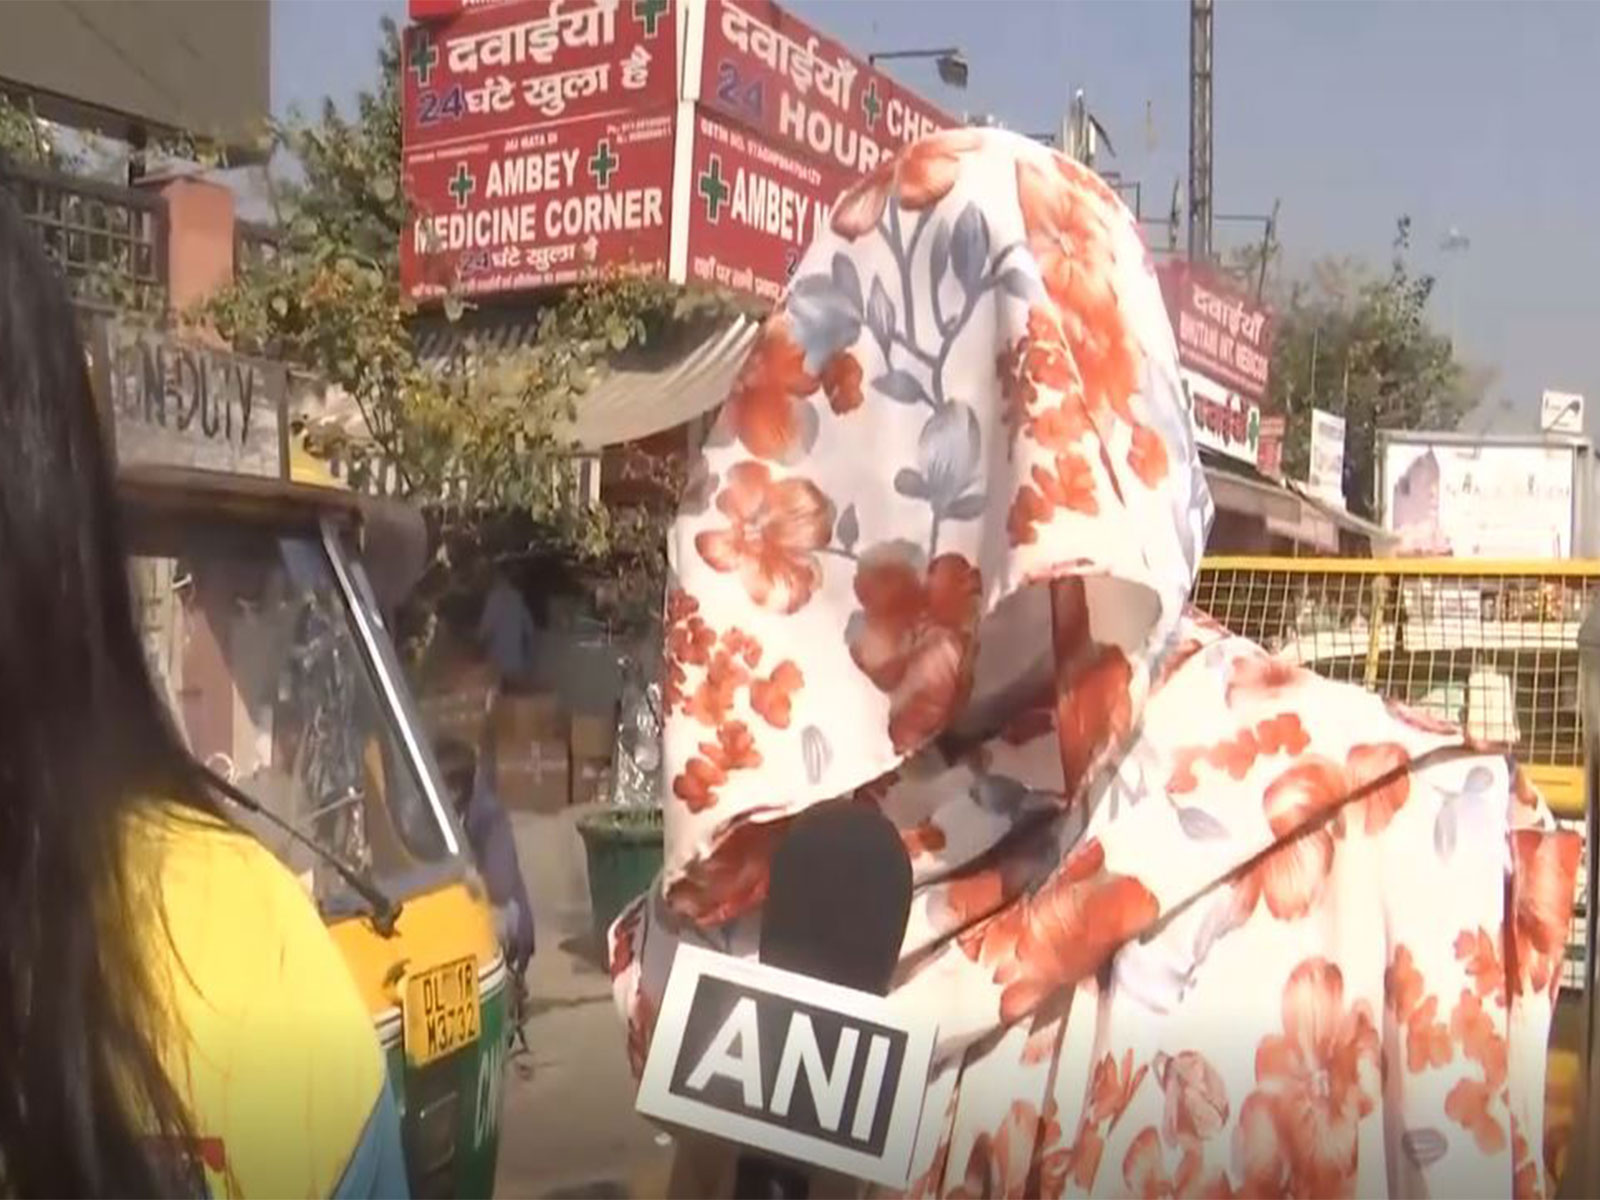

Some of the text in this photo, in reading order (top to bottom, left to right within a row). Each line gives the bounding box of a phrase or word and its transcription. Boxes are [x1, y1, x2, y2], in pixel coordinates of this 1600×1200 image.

[417, 83, 466, 127] 24
[522, 64, 610, 117] खुला
[620, 45, 652, 90] है
[717, 59, 764, 127] 24
[886, 97, 942, 146] CHE
[486, 149, 580, 199] AMBEY
[731, 167, 809, 246] AMBEY
[414, 188, 664, 254] MEDICINE CORNER
[526, 243, 576, 271] खुला
[423, 976, 444, 1017] DL
[685, 996, 891, 1143] ANI
